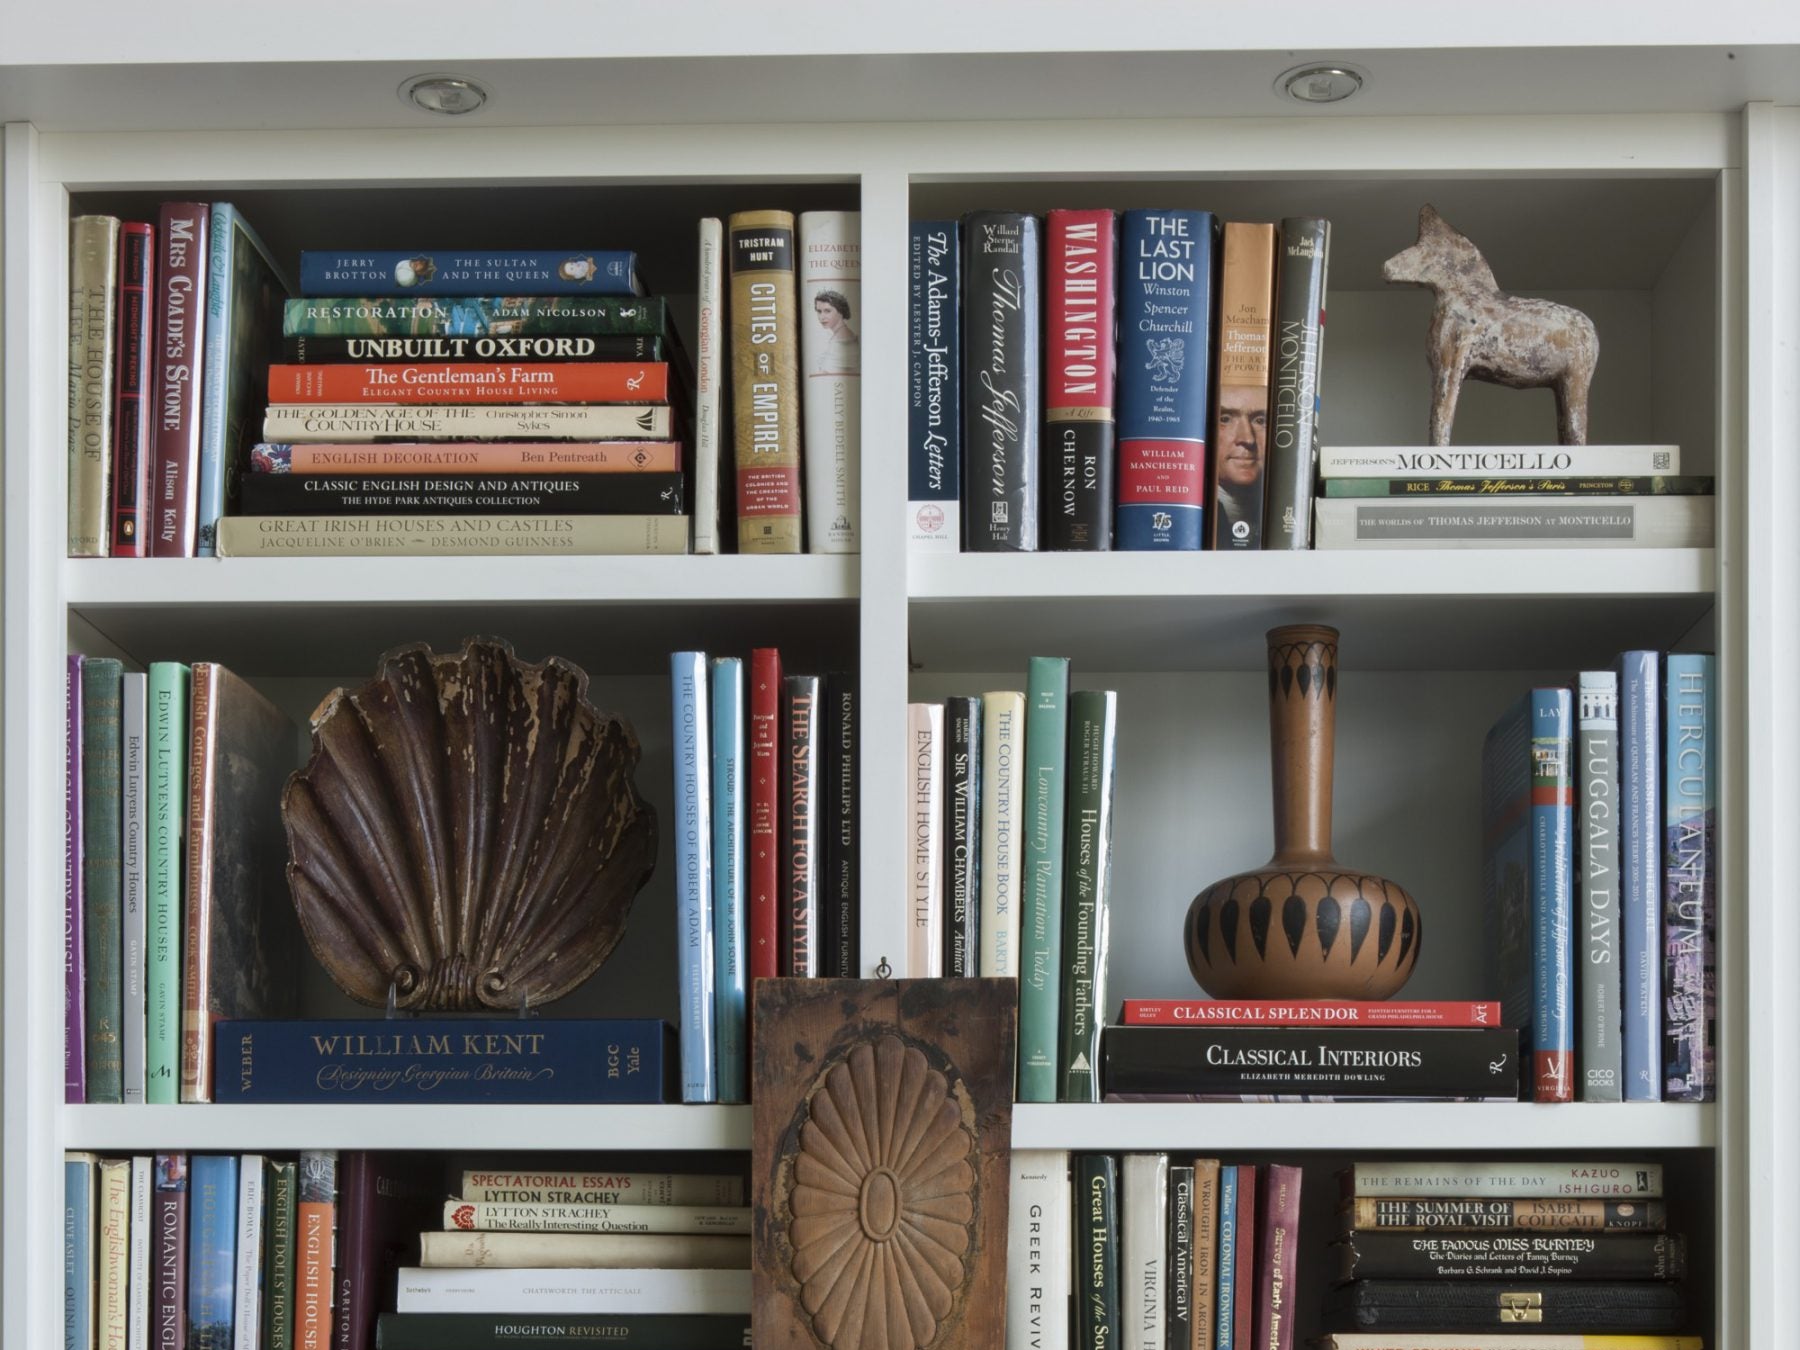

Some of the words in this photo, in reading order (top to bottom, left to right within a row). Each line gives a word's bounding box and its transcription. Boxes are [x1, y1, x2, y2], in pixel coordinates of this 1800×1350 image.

[1146, 217, 1188, 237] THE
[169, 219, 194, 268] MRS
[739, 238, 784, 248] TRISTRAM
[928, 232, 947, 266] The
[1140, 240, 1195, 259] LAST
[337, 259, 375, 267] JERRY
[455, 259, 481, 267] THE
[486, 259, 538, 267] SULTAN
[750, 251, 774, 262] HUNT
[325, 271, 386, 280] BROTTON
[442, 271, 470, 280] AND
[475, 271, 499, 280] THE
[506, 271, 550, 281] QUEEN
[1139, 261, 1194, 281] LION
[1143, 284, 1190, 297] Winston
[167, 275, 192, 359] COADE'S
[307, 306, 447, 319] RESTORATION
[493, 308, 530, 317] ADAM
[537, 308, 606, 317] NICOLSON
[751, 283, 777, 344] CITIES
[1064, 223, 1098, 395] WASHINGTON
[1144, 302, 1188, 316] Spencer
[1139, 319, 1193, 334] Churchill
[347, 339, 468, 358] UNBUILT
[475, 338, 595, 357] OXFORD
[924, 270, 948, 427] Adams-Jefferson
[760, 353, 768, 375] OF
[366, 368, 397, 384] The
[403, 368, 505, 384] Gentleman's
[511, 369, 554, 383] Farm
[164, 365, 189, 431] STONE
[753, 383, 778, 453] EMPIRE
[312, 453, 377, 464] ENGLISH
[384, 452, 479, 464] DECORATION
[521, 451, 544, 463] Ben
[548, 451, 607, 463] Pentreath
[923, 431, 947, 490] Letters
[1142, 450, 1185, 459] WILLIAM
[1397, 453, 1572, 471] MONTICELLO
[1063, 430, 1076, 516] CHERNOW
[1084, 455, 1096, 490] RON
[1129, 461, 1195, 472] MANCHESTER
[164, 460, 178, 499] Alison
[1136, 485, 1162, 494] PAUL
[1165, 485, 1189, 494] REID
[162, 509, 177, 543] Kelly
[158, 690, 171, 743] EDWIN
[918, 730, 931, 805] ENGLISH
[955, 753, 968, 777] SIR
[158, 749, 171, 822] LUTYENS
[954, 782, 968, 843] WILLIAM
[1588, 739, 1610, 879] LUGGALA
[917, 812, 931, 863] HOME
[157, 827, 168, 899] COUNTRY
[954, 846, 968, 923] CHAMBERS
[916, 873, 930, 928] STYLE
[157, 904, 168, 963] HOUSES
[1591, 890, 1610, 964] DAYS
[1174, 1006, 1264, 1020] CLASSICAL
[1268, 1006, 1358, 1020] SPLENDOR
[311, 1034, 450, 1056] WILLIAM
[462, 1034, 545, 1055] KENT
[1206, 1045, 1312, 1066] CLASSICAL
[1318, 1046, 1422, 1067] INTERIORS
[240, 1033, 252, 1092] WEBER
[608, 1044, 619, 1078] BGC
[628, 1046, 639, 1075] Yale
[1294, 1073, 1341, 1081] MEREDITH
[1587, 1069, 1615, 1079] CICO
[1588, 1078, 1615, 1087] BOOKS
[472, 1175, 577, 1187] SPECTATORIAL
[582, 1176, 631, 1189] ESSAYS
[1571, 1169, 1620, 1179] KAZUO
[1559, 1183, 1632, 1194] ISHIGURO
[161, 1200, 177, 1299] ROMANTIC
[1030, 1205, 1042, 1273] GREEK
[305, 1213, 321, 1288] ENGLISH
[341, 1279, 350, 1346] CARLTON
[495, 1326, 565, 1336] HOUGHTON
[569, 1326, 629, 1337] REVISITED
